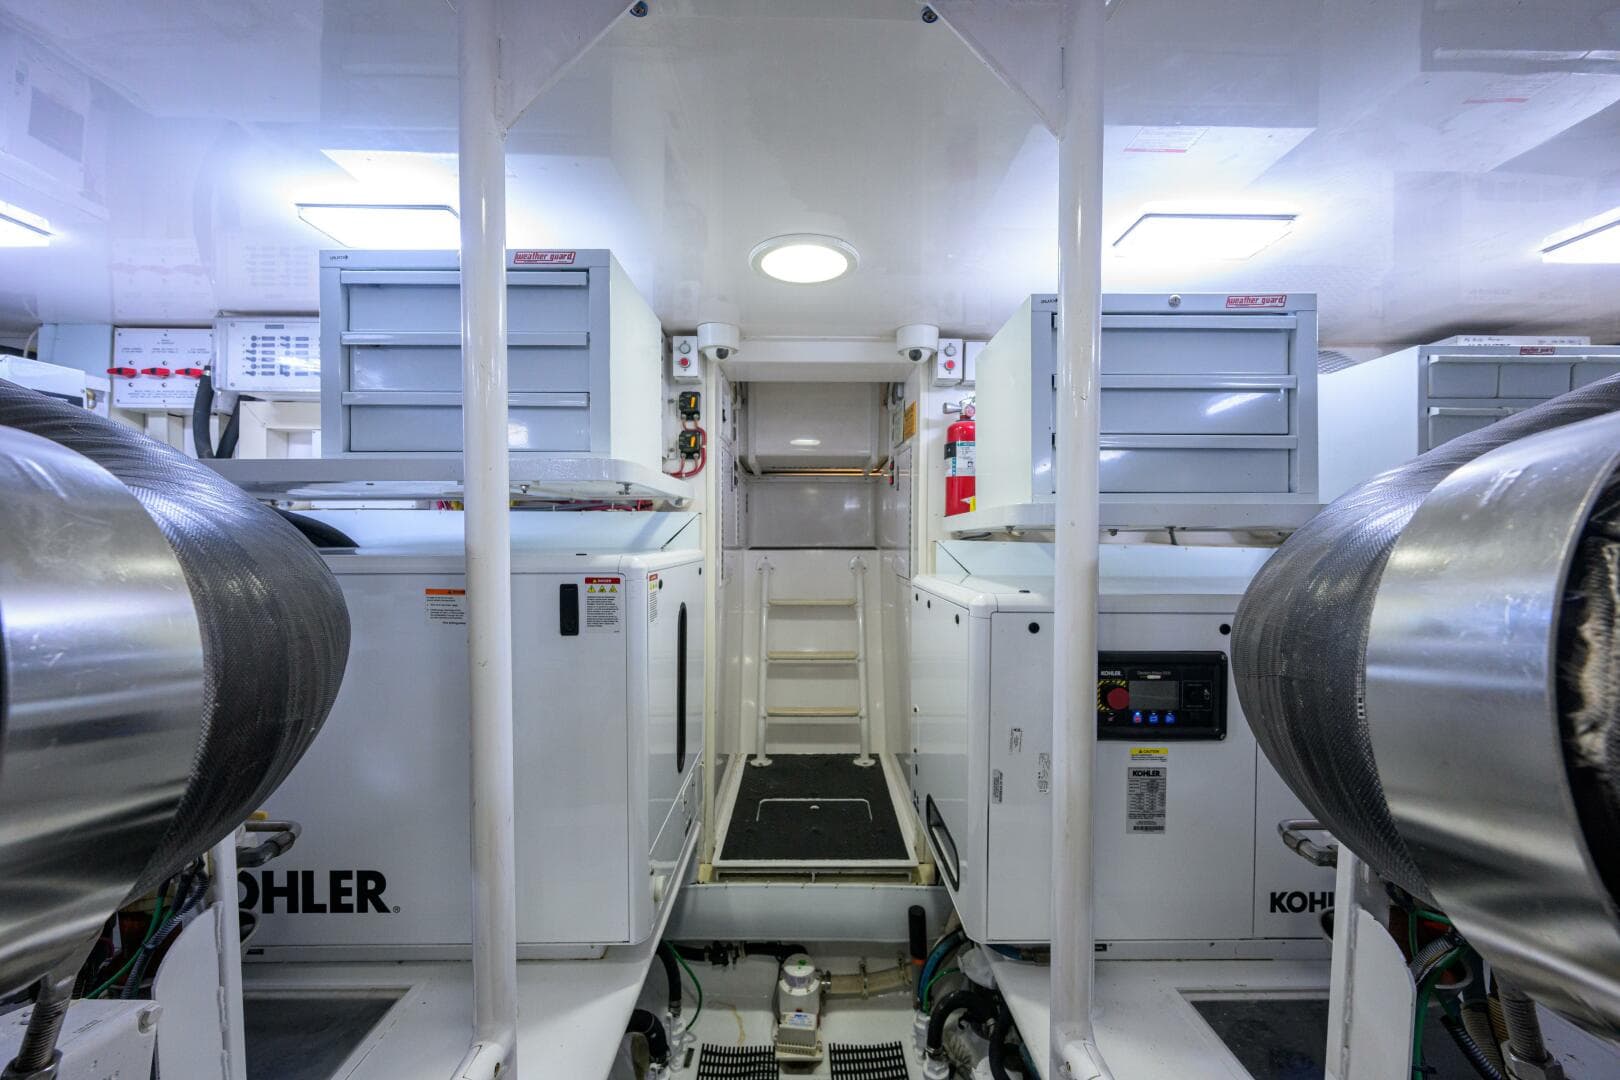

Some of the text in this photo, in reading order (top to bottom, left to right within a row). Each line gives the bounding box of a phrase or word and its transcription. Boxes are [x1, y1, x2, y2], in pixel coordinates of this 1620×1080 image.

[516, 252, 573, 262] weather guard
[1228, 296, 1284, 305] weather guard
